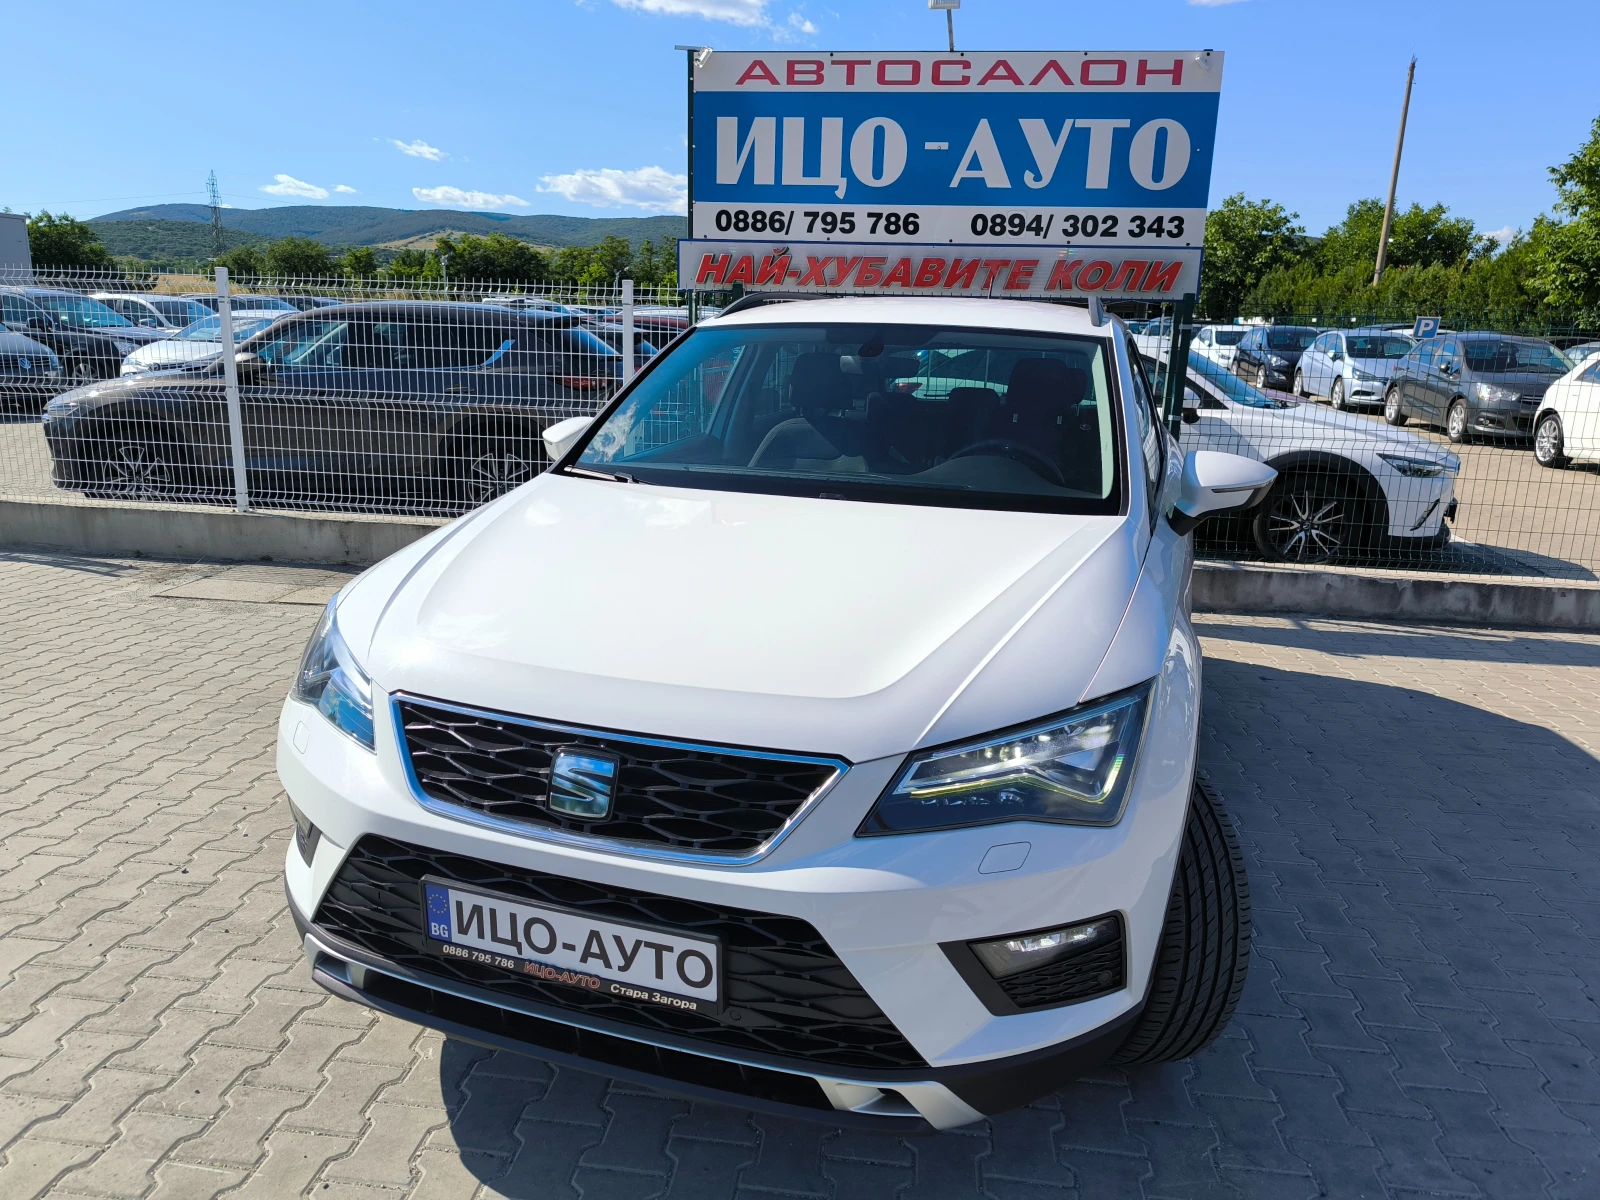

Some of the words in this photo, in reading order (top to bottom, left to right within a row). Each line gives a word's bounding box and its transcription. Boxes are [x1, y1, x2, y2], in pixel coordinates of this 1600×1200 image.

[735, 59, 1183, 86] АВТОСАЛОН
[715, 116, 1192, 200] ИЦО-АУТО
[715, 209, 795, 236] 0886/
[803, 211, 856, 235] 795
[866, 212, 920, 236] 786
[970, 213, 1054, 239] 0894/
[1061, 214, 1119, 238] 302
[1127, 215, 1185, 239] 343
[695, 246, 1040, 291] НАЙ-ХУБАВИТЕ
[1045, 259, 1184, 292] КОЛИ
[1417, 319, 1434, 336] P
[431, 922, 449, 938] BG
[455, 899, 714, 990] ИЦО-АУТО
[442, 944, 469, 958] 0886
[471, 951, 492, 963] 795
[494, 956, 515, 969] 786
[523, 961, 601, 989] ИЦО-АУТО
[610, 983, 649, 1001] Стара
[651, 992, 698, 1011] Загора
